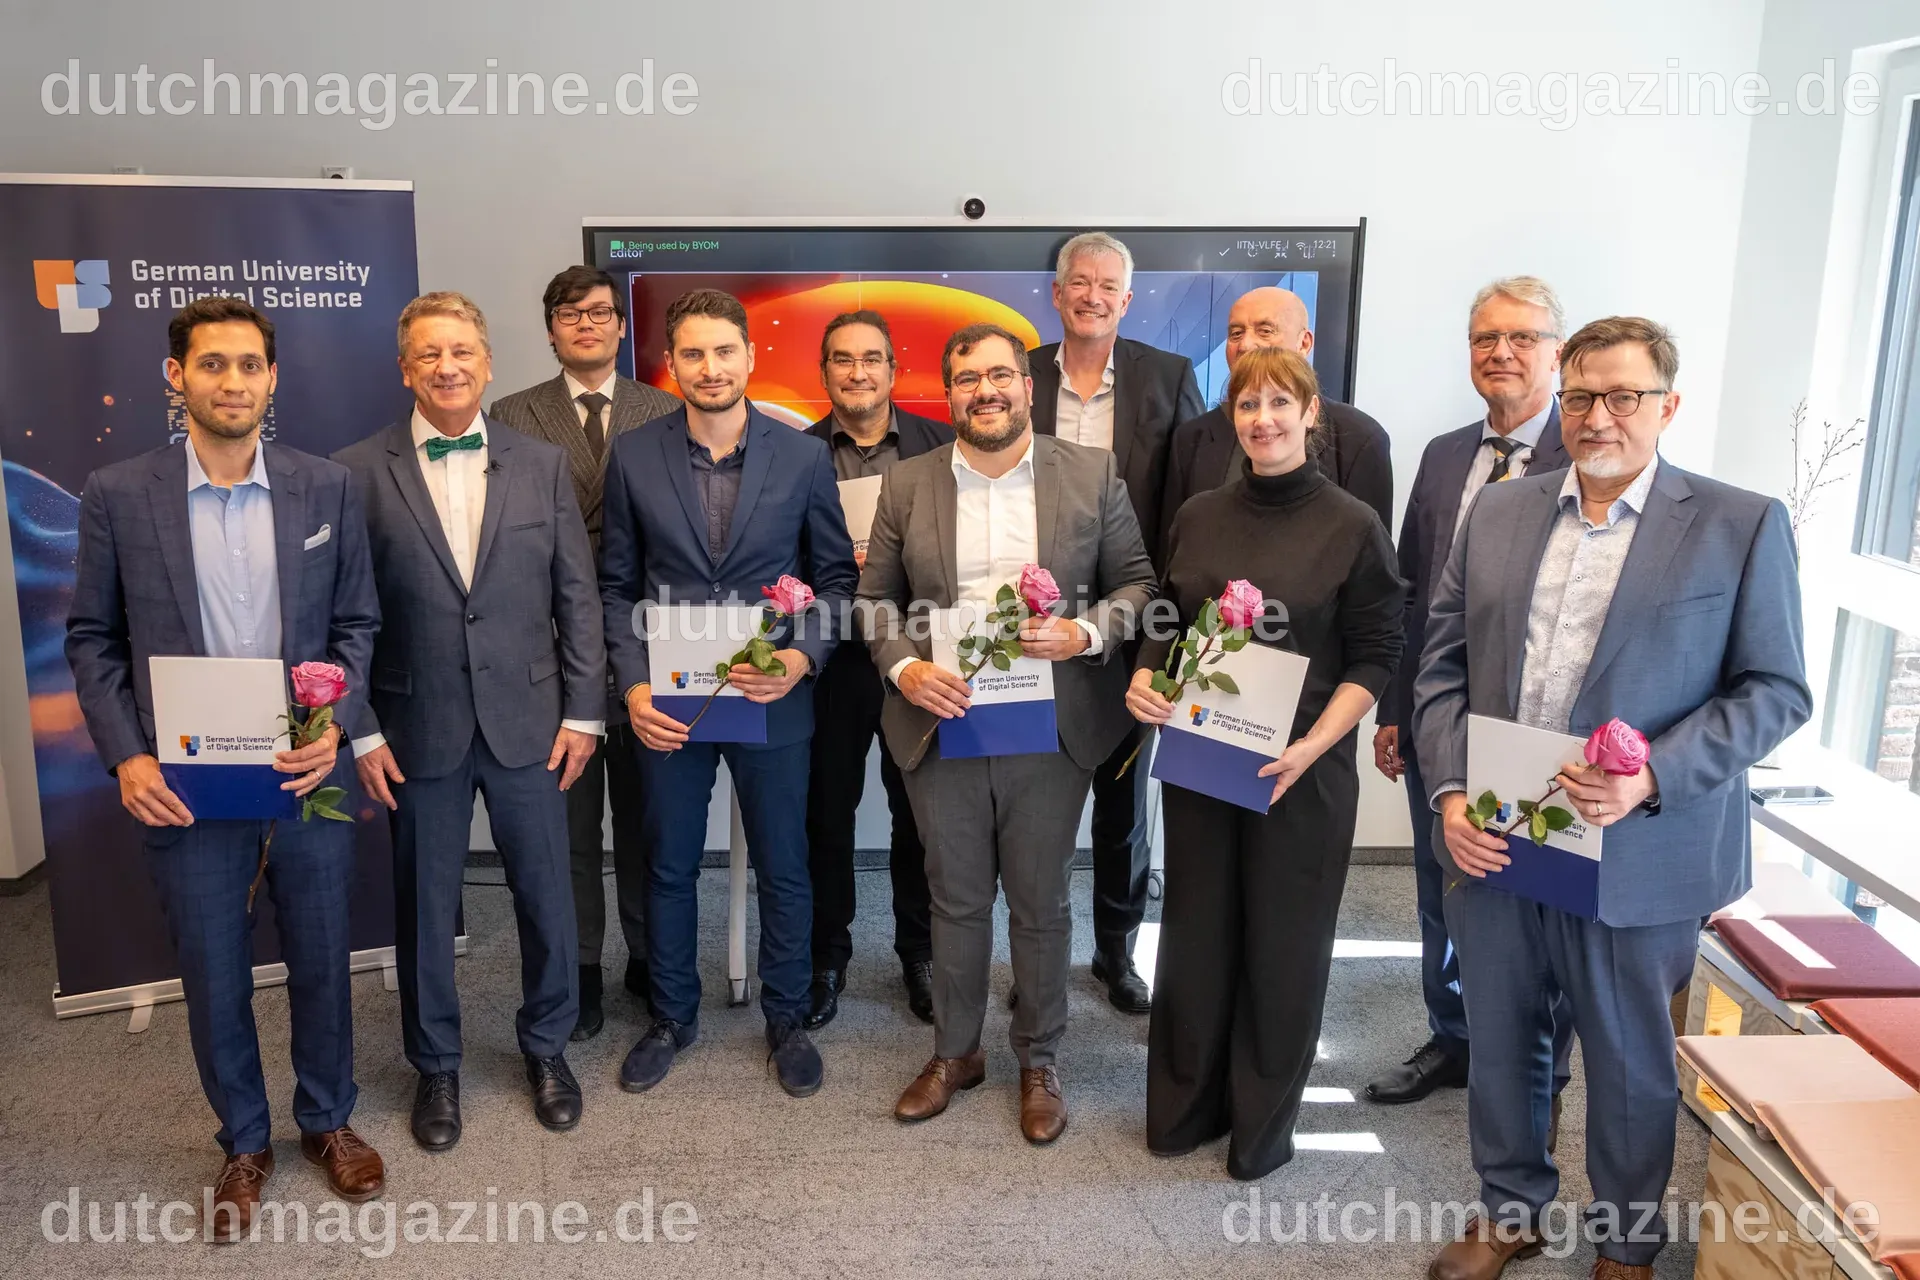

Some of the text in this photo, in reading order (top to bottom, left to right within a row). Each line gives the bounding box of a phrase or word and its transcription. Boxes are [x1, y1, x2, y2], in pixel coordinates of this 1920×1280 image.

[629, 241, 719, 252] Being used by BYOM
[1313, 240, 1336, 250] 12:21
[610, 247, 644, 258] Editor
[131, 259, 371, 287] German University
[134, 287, 161, 309] of
[263, 286, 363, 308] Science
[1005, 673, 1040, 682] University
[987, 683, 1010, 692] Digital
[1011, 681, 1038, 689] Science
[1213, 710, 1277, 736] German University
[1220, 720, 1244, 733] Digital
[1244, 727, 1272, 742] Science
[205, 735, 276, 745] German University
[216, 743, 241, 752] Digital
[242, 743, 273, 751] Science
